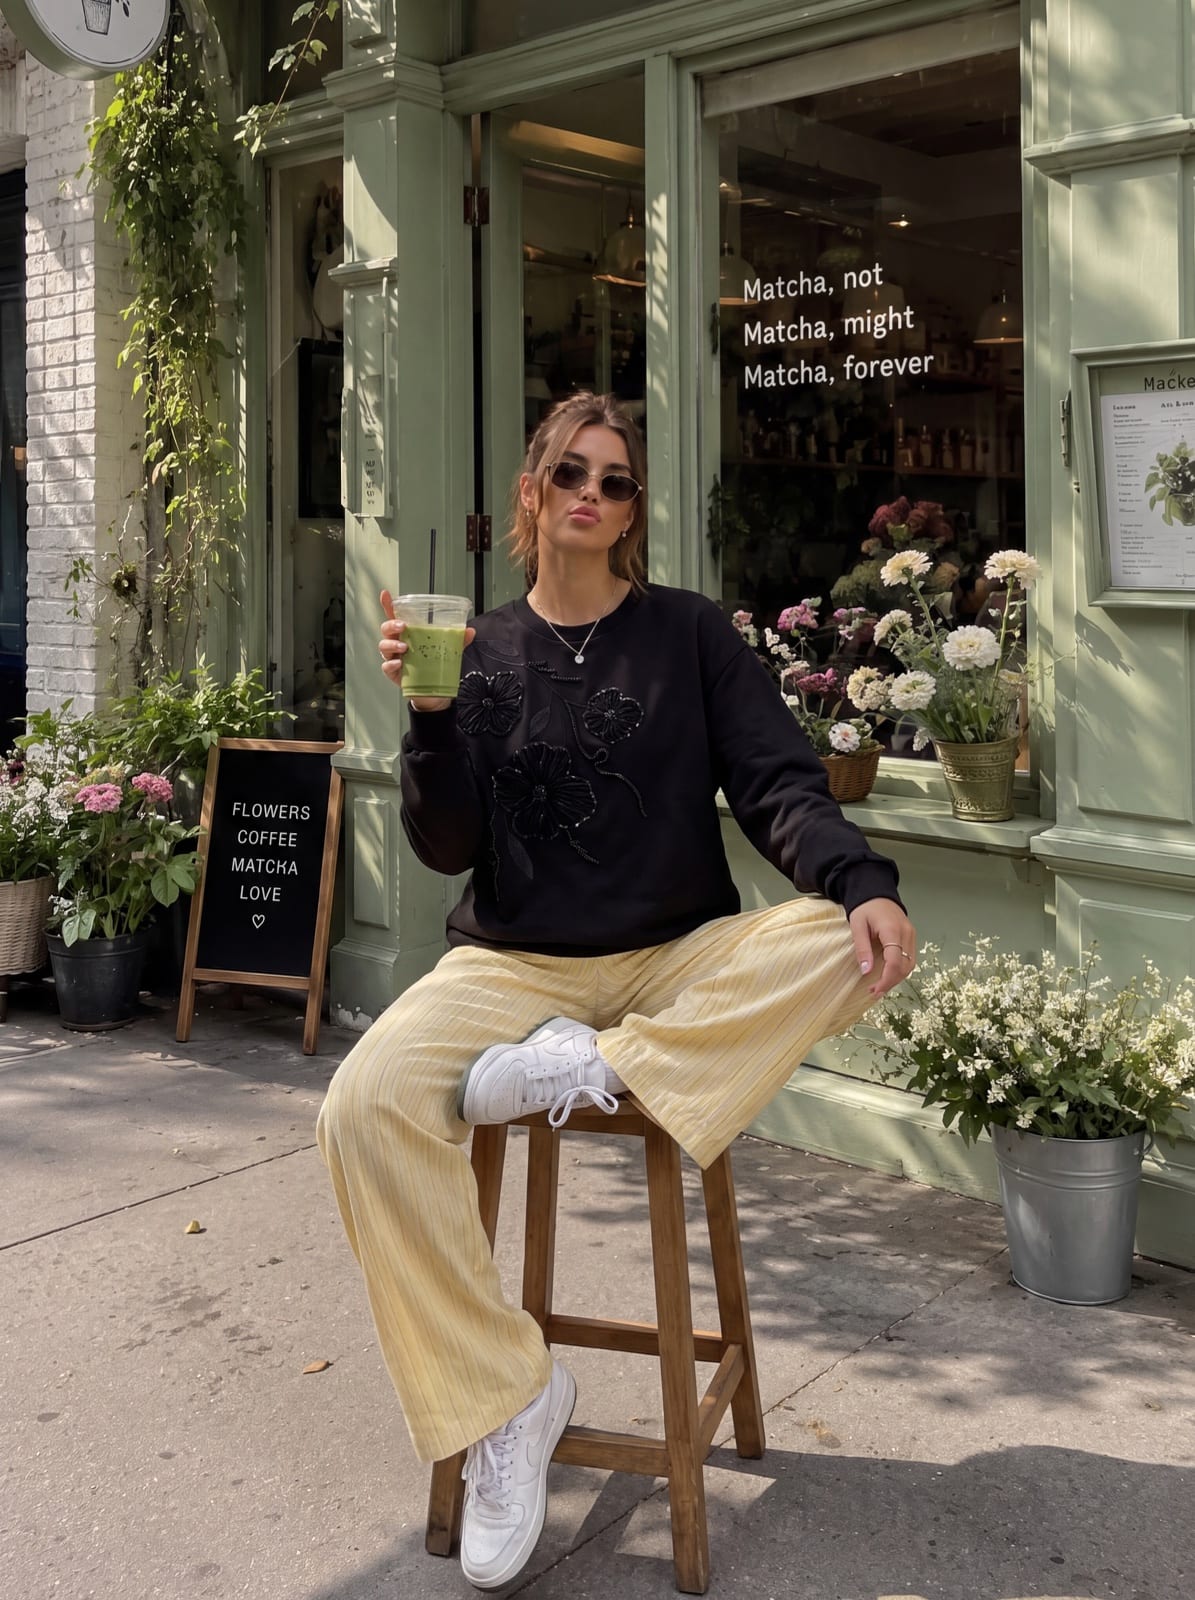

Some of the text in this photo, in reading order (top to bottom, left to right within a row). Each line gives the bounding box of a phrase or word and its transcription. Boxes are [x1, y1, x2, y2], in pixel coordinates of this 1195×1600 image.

[743, 262, 884, 303] Matcha, not
[744, 305, 915, 347] Matcha, might
[744, 354, 934, 390] Matcha, forever
[232, 802, 311, 820] FLOWERS
[237, 829, 298, 848] COFFEE
[231, 857, 298, 876] MATCKA
[239, 885, 282, 902] LOVE
